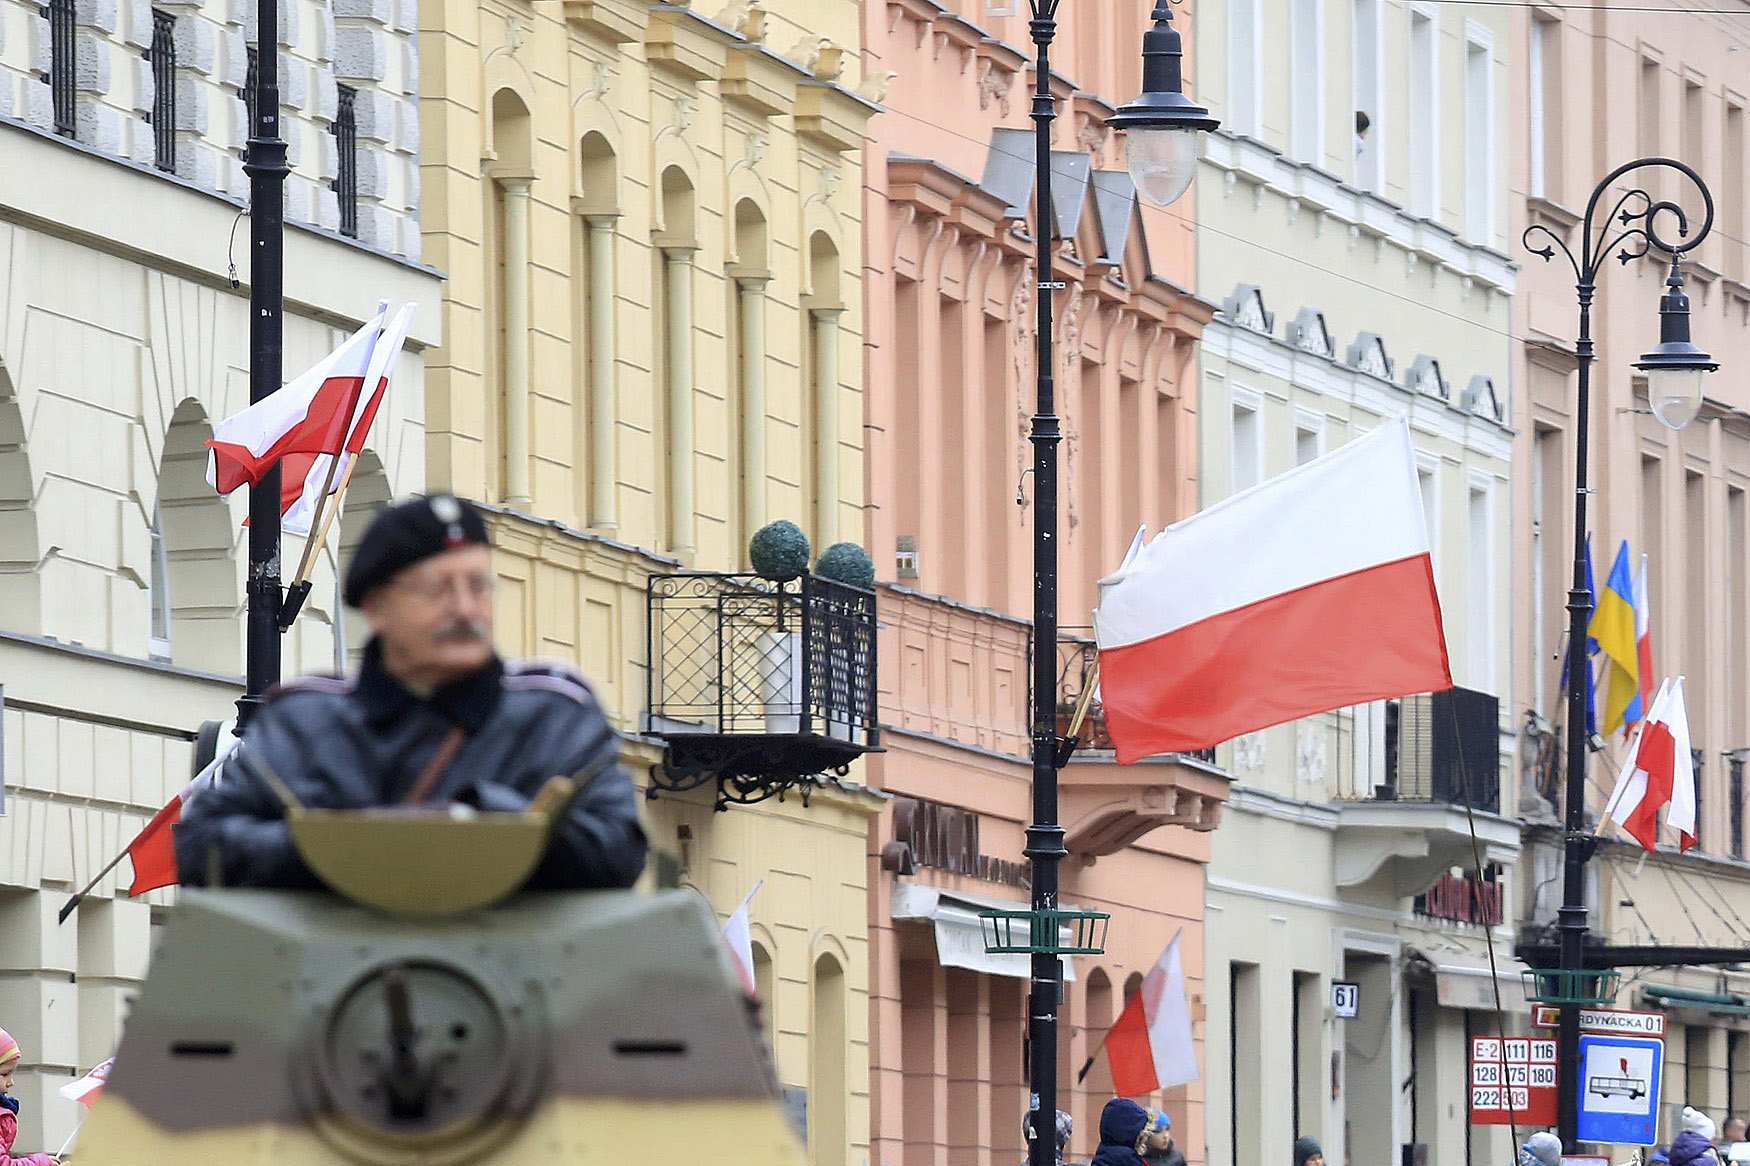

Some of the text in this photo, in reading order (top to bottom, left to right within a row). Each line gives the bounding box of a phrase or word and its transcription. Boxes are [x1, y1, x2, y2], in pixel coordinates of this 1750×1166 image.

[1335, 987, 1354, 1007] 61
[1645, 1016, 1661, 1032] 01
[1476, 1042, 1554, 1059] E-2 111 116
[1475, 1066, 1553, 1083] 128 75 180
[1474, 1090, 1500, 1106] 222
